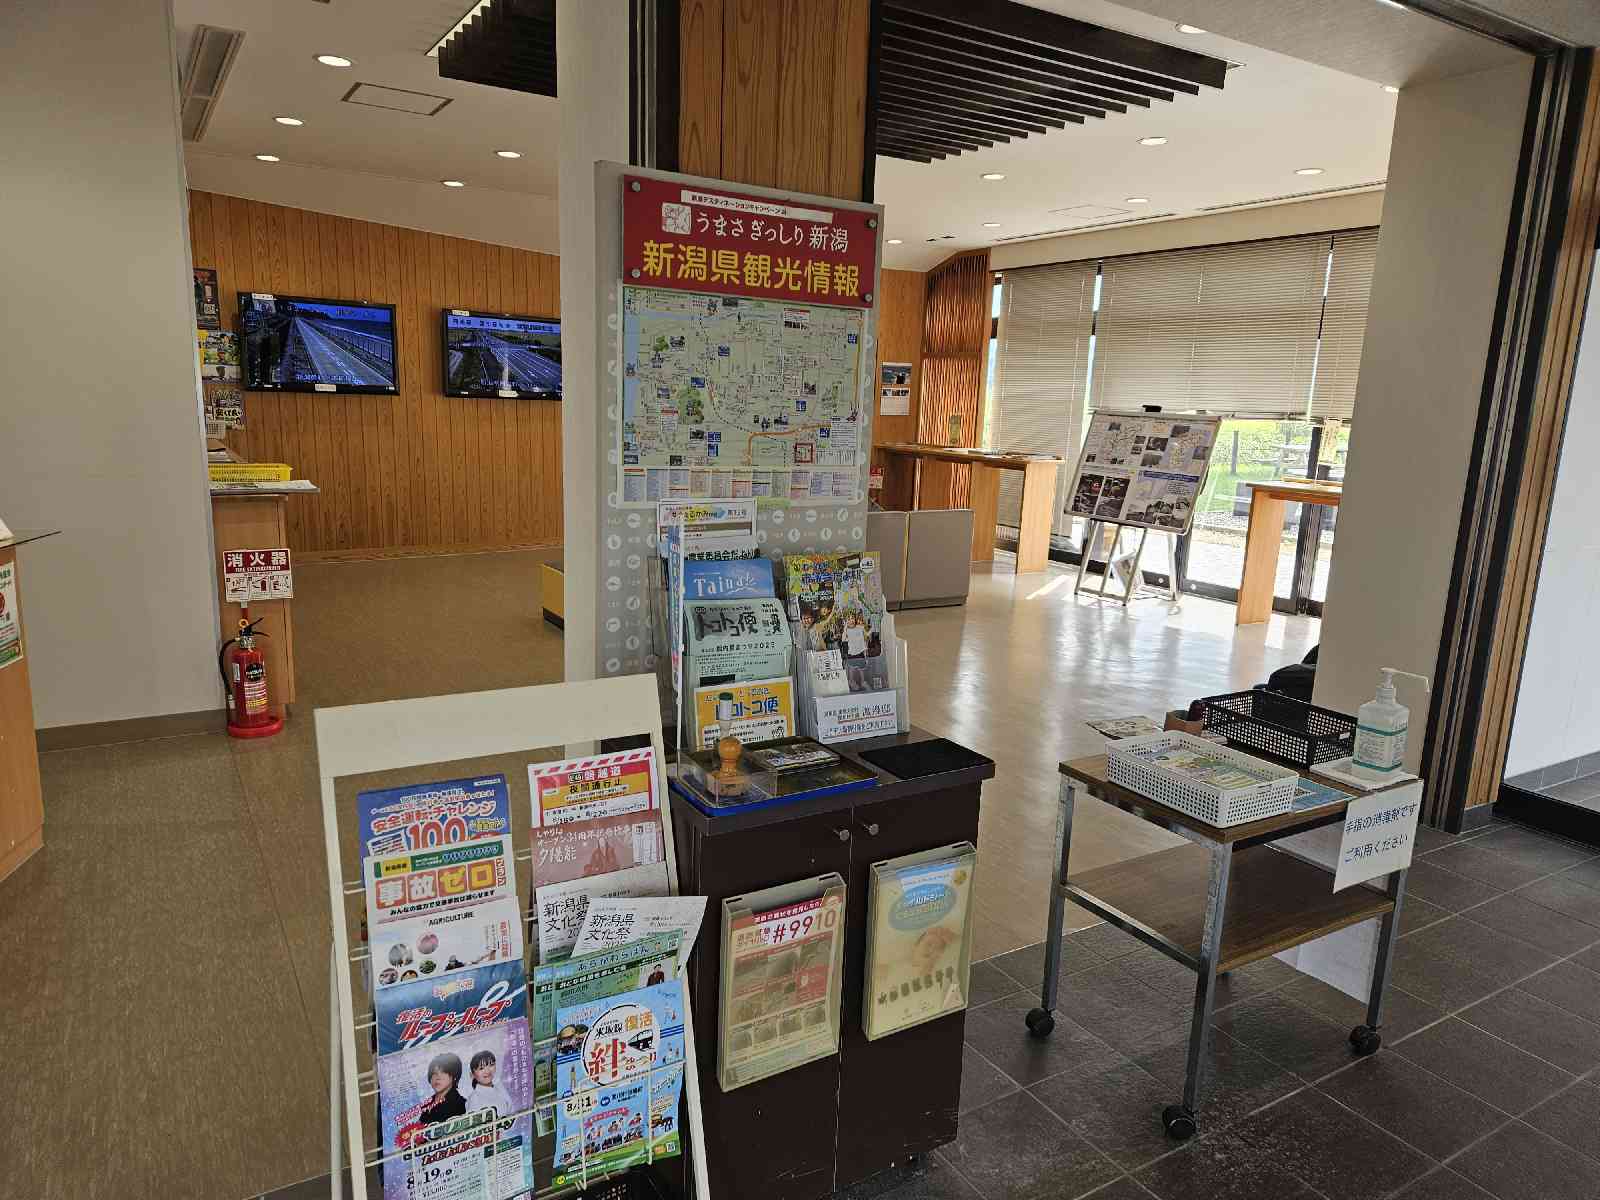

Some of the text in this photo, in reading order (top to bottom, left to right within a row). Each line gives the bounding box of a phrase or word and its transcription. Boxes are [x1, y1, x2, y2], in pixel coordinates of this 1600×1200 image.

[642, 239, 860, 297] 新潟県観光情報
[227, 550, 288, 568] 消火器
[1345, 801, 1418, 832] 手指の消毒剤です
[1344, 833, 1408, 864] ご利用ください
[543, 894, 590, 918] 新潟県
[590, 913, 635, 928] 新潟県
[584, 927, 632, 942] 文化祭
[773, 909, 836, 944] #9910
[589, 1038, 627, 1082] 絆
